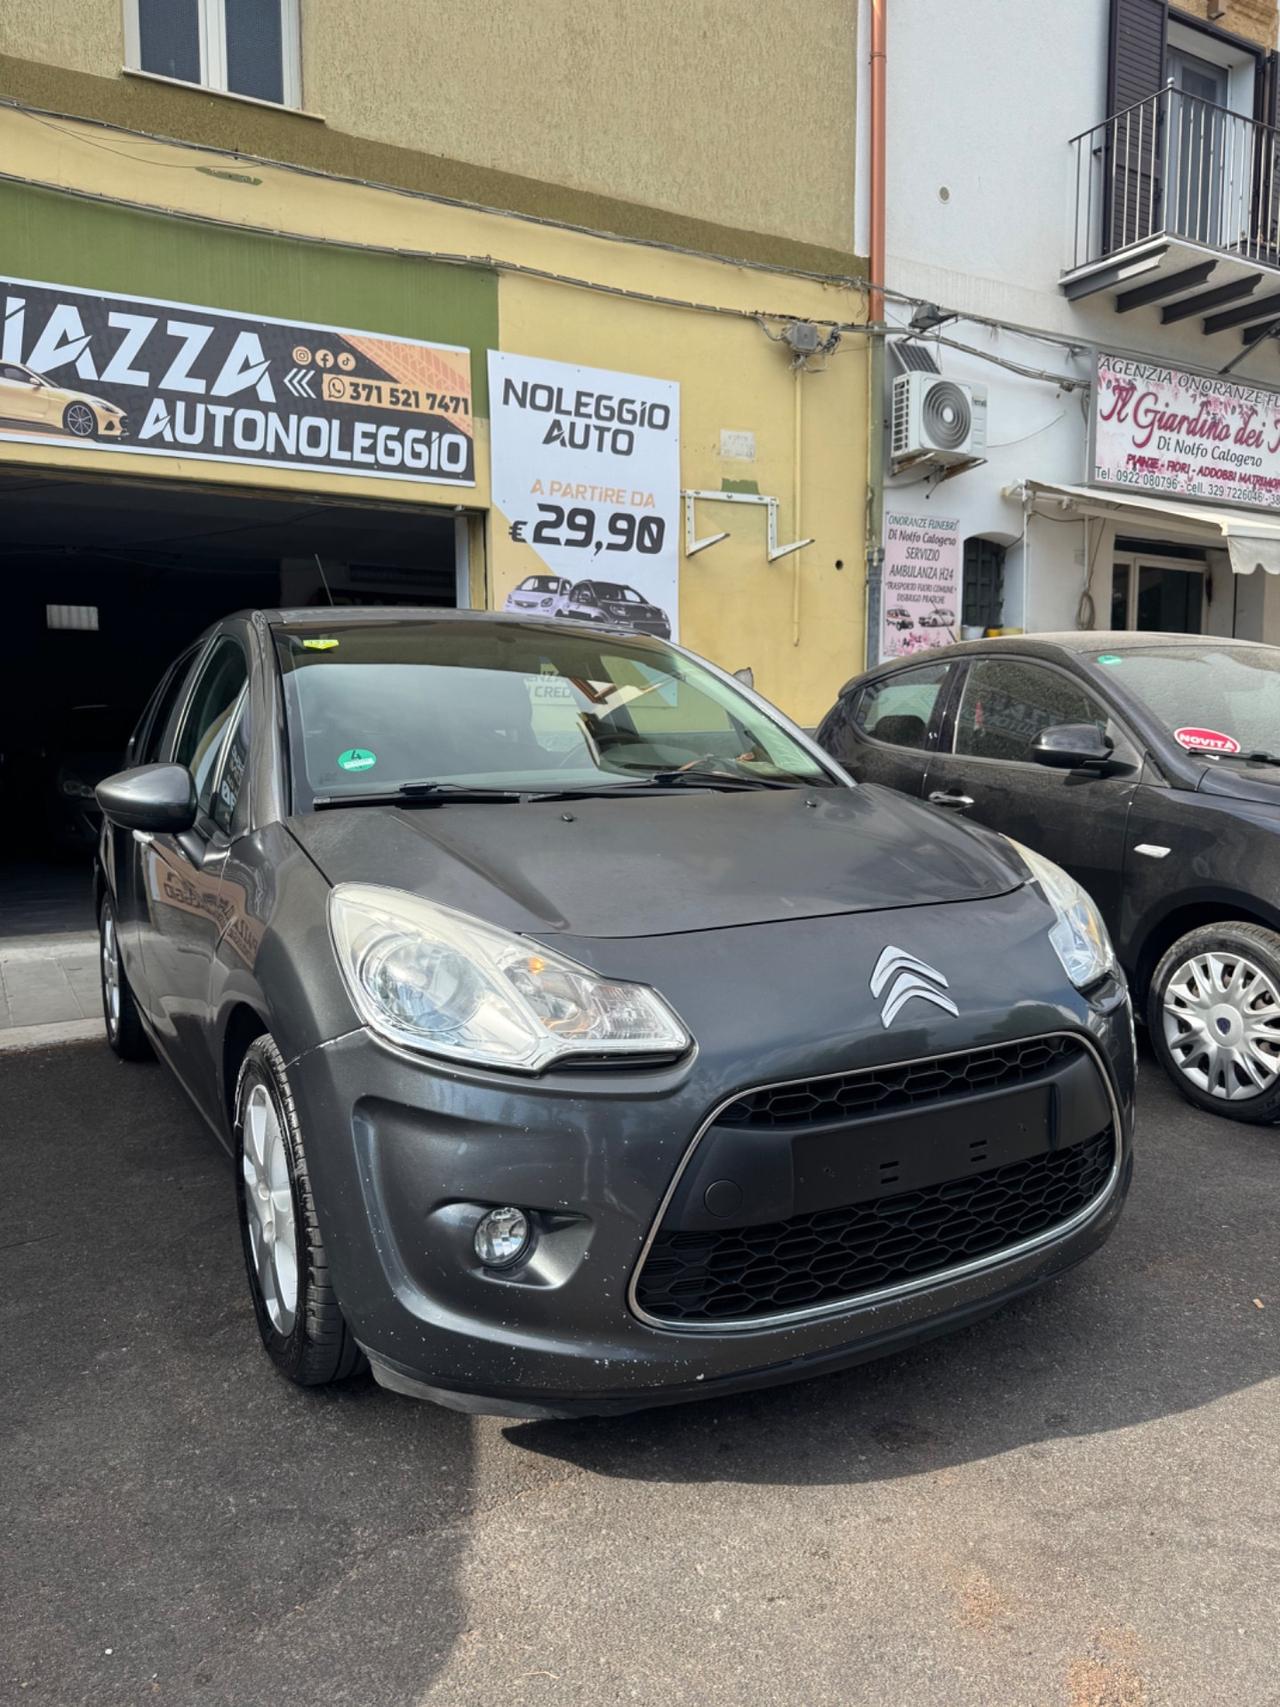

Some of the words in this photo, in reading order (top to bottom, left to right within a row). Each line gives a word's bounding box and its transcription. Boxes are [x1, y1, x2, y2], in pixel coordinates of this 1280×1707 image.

[1099, 357, 1172, 385] AGENZIA
[1178, 375, 1263, 404] ONORANZE
[349, 383, 382, 404] 371
[389, 388, 420, 409] 521
[426, 392, 469, 415] 7471
[502, 377, 671, 431] NOLEGGIO
[138, 397, 468, 474] AUTONOLEGGIO
[1132, 391, 1231, 449] Giardino
[1233, 407, 1265, 449] dei
[542, 418, 635, 456] AUTO
[1157, 435, 1171, 451] Di
[1174, 438, 1208, 459] Nolfo
[1211, 445, 1263, 468] Calogero
[530, 478, 545, 496] A
[630, 490, 656, 509] DA
[1095, 465, 1112, 480] Tel.
[1116, 469, 1140, 484] 0922
[1143, 473, 1178, 490] 080796
[1208, 484, 1225, 496] 329
[532, 502, 665, 556] 29,90
[888, 515, 928, 529] ONORANZE
[888, 528, 898, 541] Di
[905, 546, 940, 561] SERVIZIO
[889, 564, 938, 580] AMBULANZA
